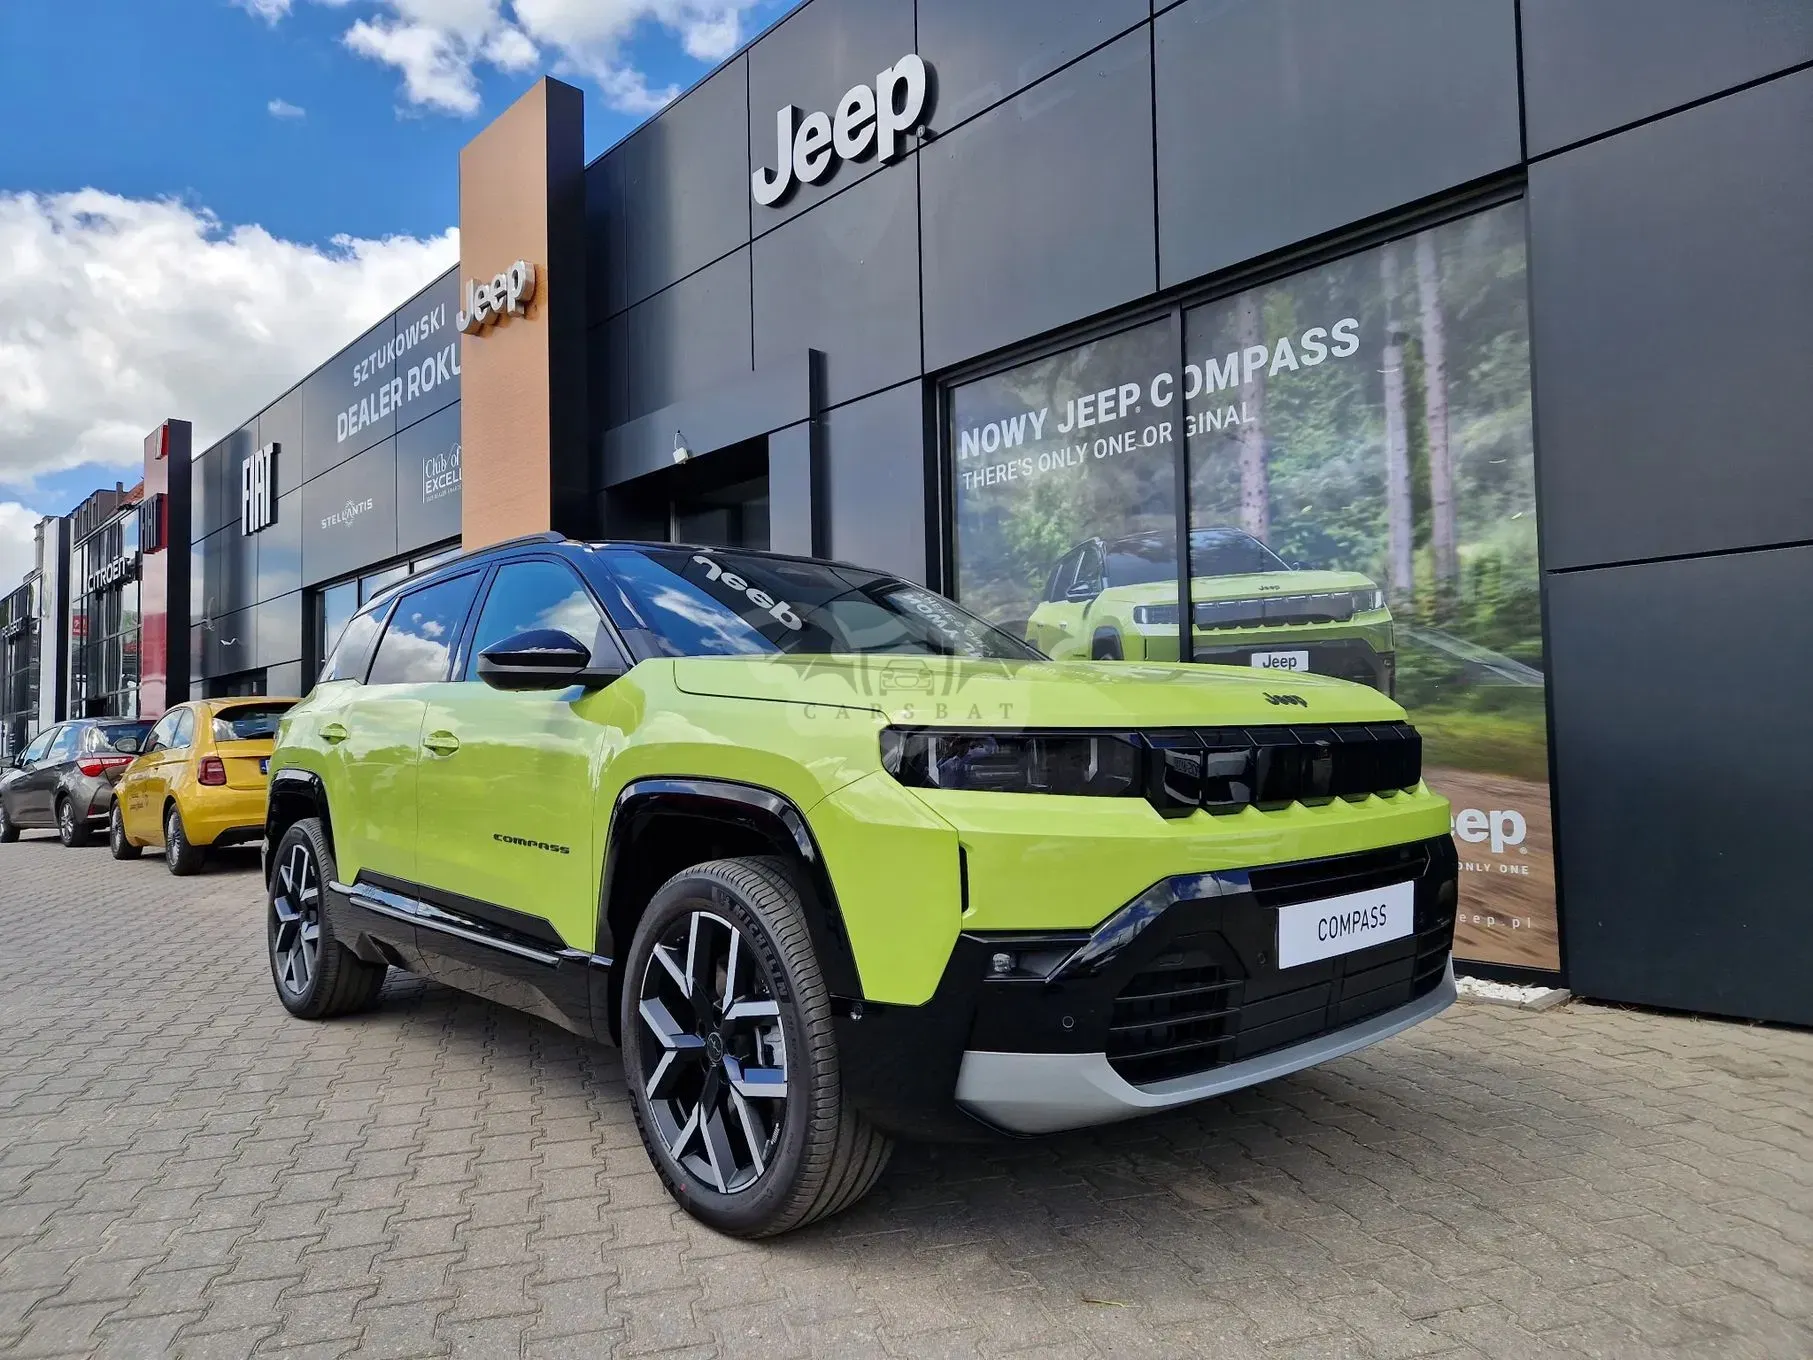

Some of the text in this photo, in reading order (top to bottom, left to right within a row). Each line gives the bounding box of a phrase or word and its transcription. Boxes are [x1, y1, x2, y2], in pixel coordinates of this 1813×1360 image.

[752, 53, 927, 206] Jeep
[455, 259, 536, 335] Jeep
[353, 302, 446, 387] SZTUKOWSKI
[337, 377, 403, 443] DEALER
[961, 317, 1361, 460] NOWY JEEP COMPASS
[425, 453, 447, 479] Club
[962, 402, 1256, 491] THERE'S ONLY ONE ORGINAL
[241, 442, 278, 536] FIAT
[321, 497, 373, 529] STELLANTIS
[1262, 654, 1298, 670] Jeep
[1450, 808, 1527, 853] ep
[1499, 864, 1530, 875] ONE
[1317, 903, 1388, 943] COMPASS
[1459, 913, 1532, 930] eep.pl
